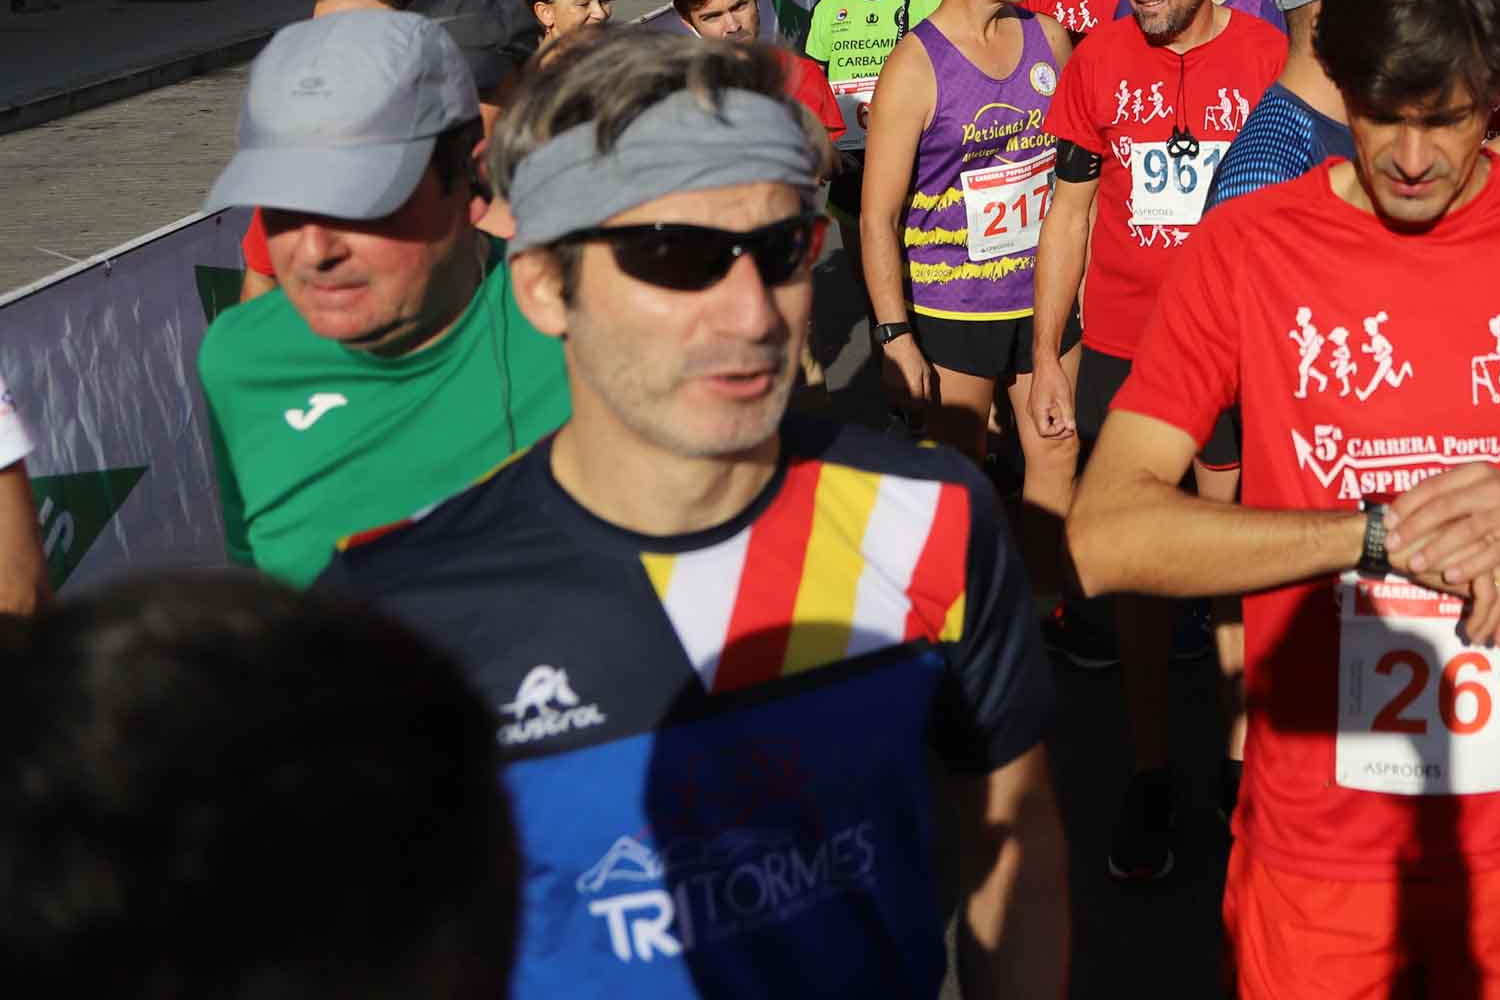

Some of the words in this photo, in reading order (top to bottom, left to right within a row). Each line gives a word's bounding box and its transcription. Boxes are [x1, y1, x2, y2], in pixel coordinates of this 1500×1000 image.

[961, 118, 1025, 146] Persianas
[983, 184, 1051, 238] 217
[1347, 435, 1438, 458] CARRERA
